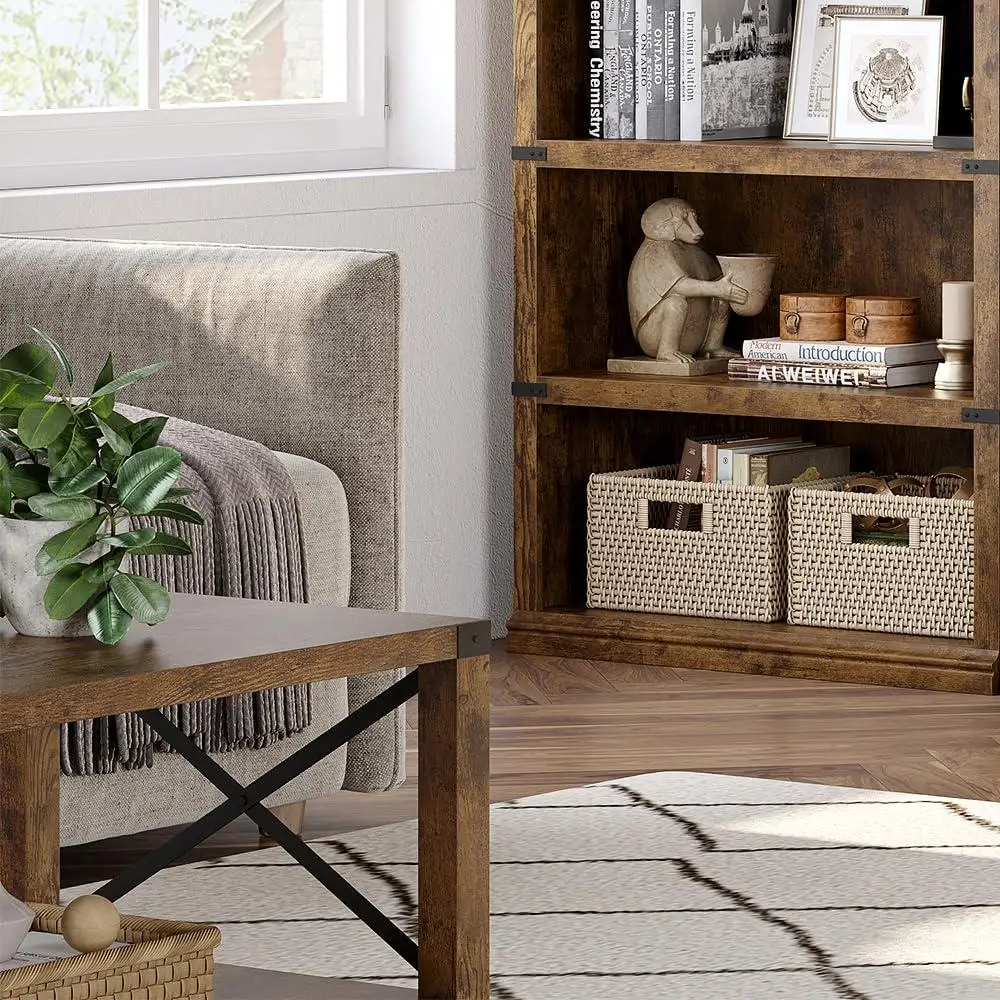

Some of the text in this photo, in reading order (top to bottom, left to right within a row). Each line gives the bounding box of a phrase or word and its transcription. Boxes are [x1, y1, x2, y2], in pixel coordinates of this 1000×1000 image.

[622, 0, 631, 24] SCHOOL
[667, 10, 676, 56] Forming
[685, 11, 696, 56] Forming
[604, 47, 618, 91] ENGLAND
[618, 46, 634, 92] ENGLAND
[654, 28, 662, 85] ONTARIO
[588, 57, 604, 138] Chemistry
[667, 66, 676, 101] Nation
[686, 67, 696, 102] Nation
[748, 351, 788, 360] American
[750, 340, 782, 350] Modern
[798, 344, 883, 363] Introduction
